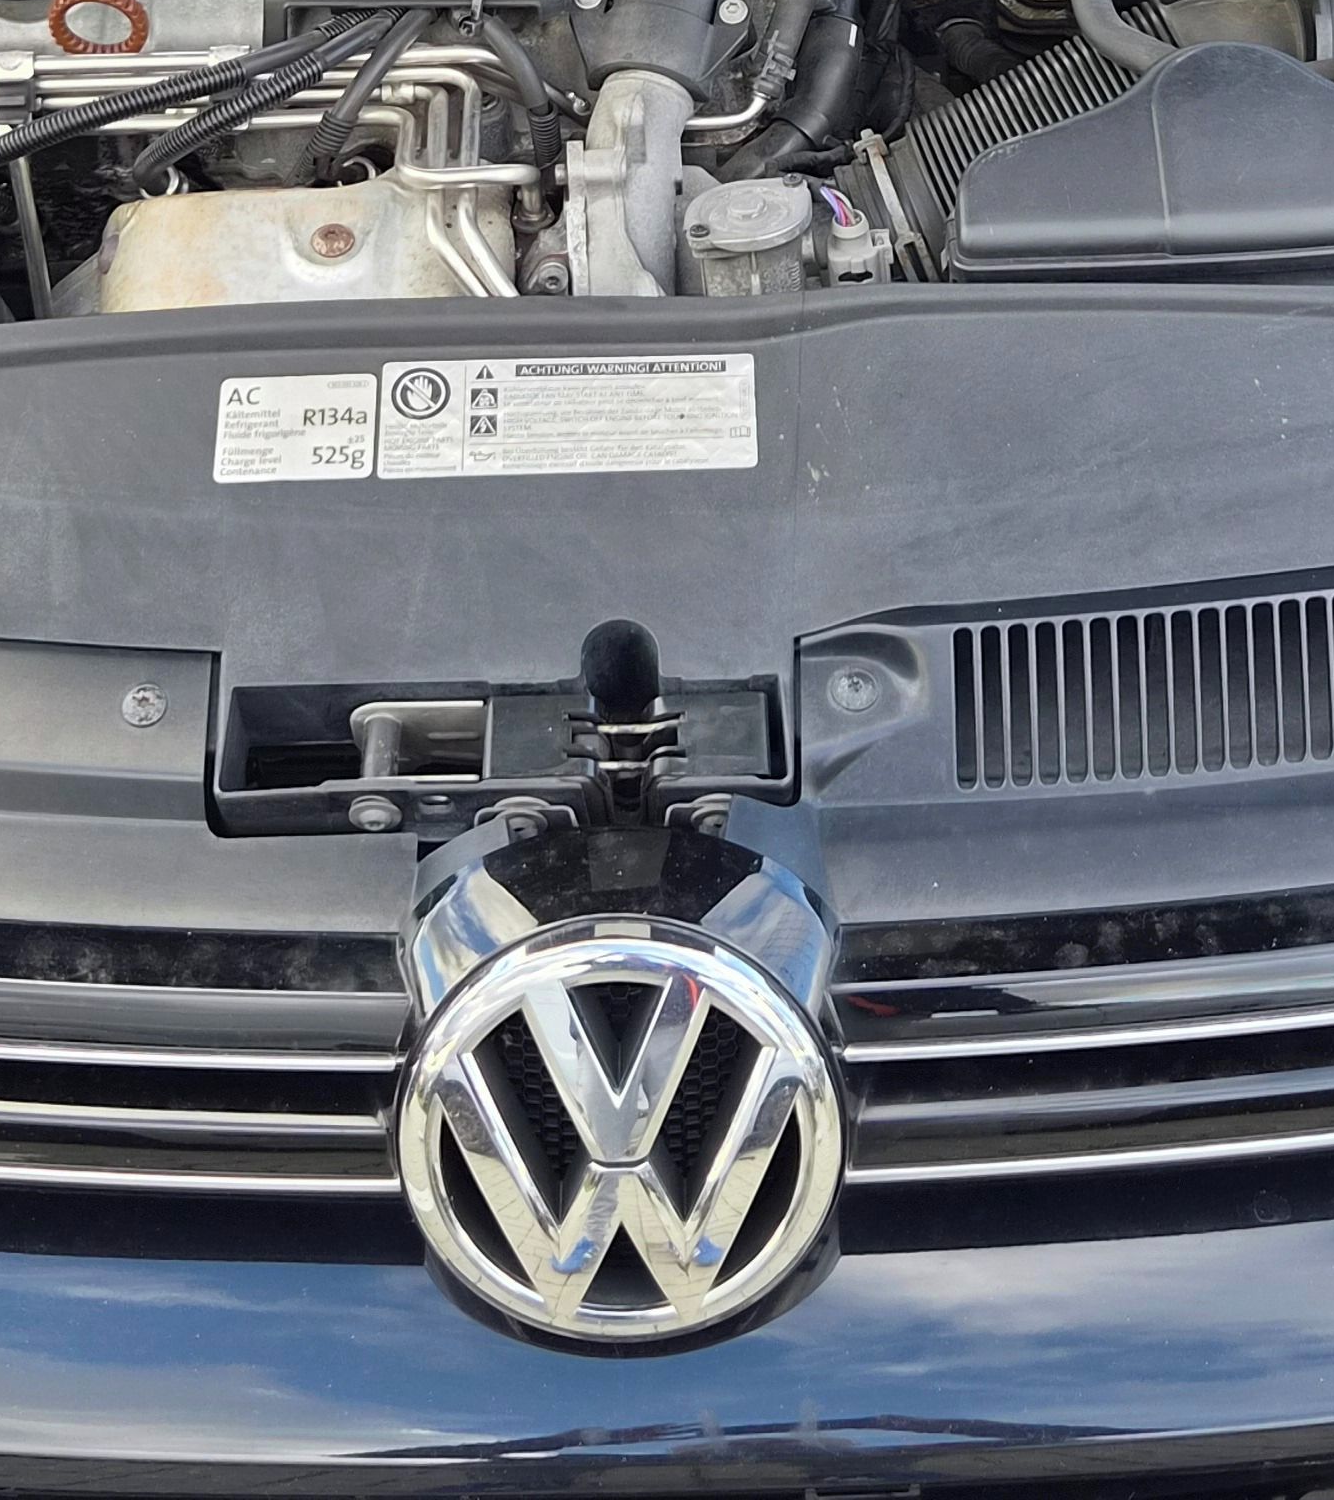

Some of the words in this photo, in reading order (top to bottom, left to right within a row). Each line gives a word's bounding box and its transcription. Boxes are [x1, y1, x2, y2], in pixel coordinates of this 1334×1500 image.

[520, 365, 584, 376] ACHTUNG!
[587, 363, 649, 374] WARNING!
[652, 361, 722, 373] ATTENTION!
[226, 386, 261, 406] AC
[303, 407, 367, 426] R134a
[311, 446, 366, 470] 525g
[412, 950, 832, 1328] VW
